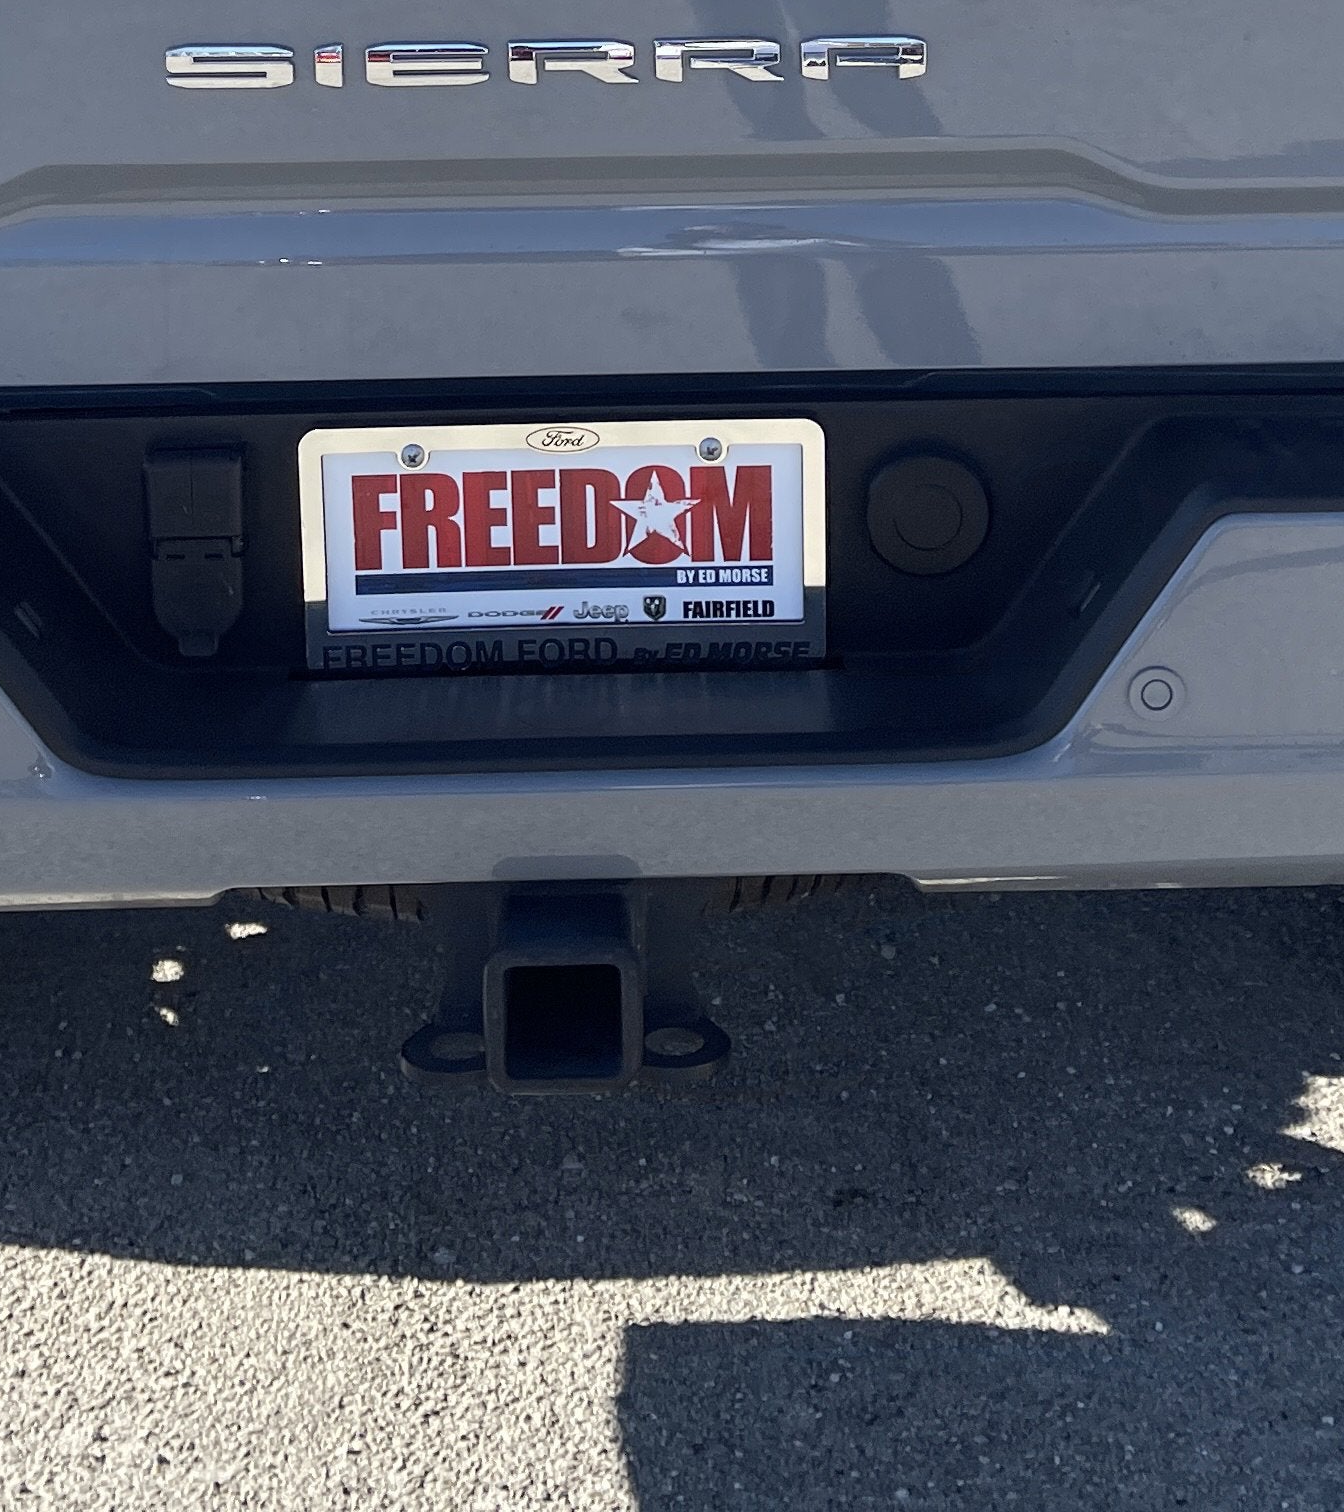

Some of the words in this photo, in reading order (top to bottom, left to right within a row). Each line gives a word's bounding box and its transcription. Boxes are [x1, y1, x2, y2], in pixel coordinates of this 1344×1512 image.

[165, 35, 928, 89] SIERRA
[541, 430, 585, 447] Ford
[352, 465, 773, 571] FREEDOM
[676, 569, 695, 584] BY
[698, 569, 716, 584] ED
[719, 568, 769, 584] MORSE
[370, 607, 447, 615] CHRYSLER
[467, 609, 544, 619] DODGE
[573, 600, 629, 622] Jeep
[682, 600, 775, 619] FAIRFIELD
[322, 639, 504, 671] FREEDOM
[518, 637, 618, 668] FORD
[664, 641, 702, 662] ED
[707, 640, 811, 663] MORSE
